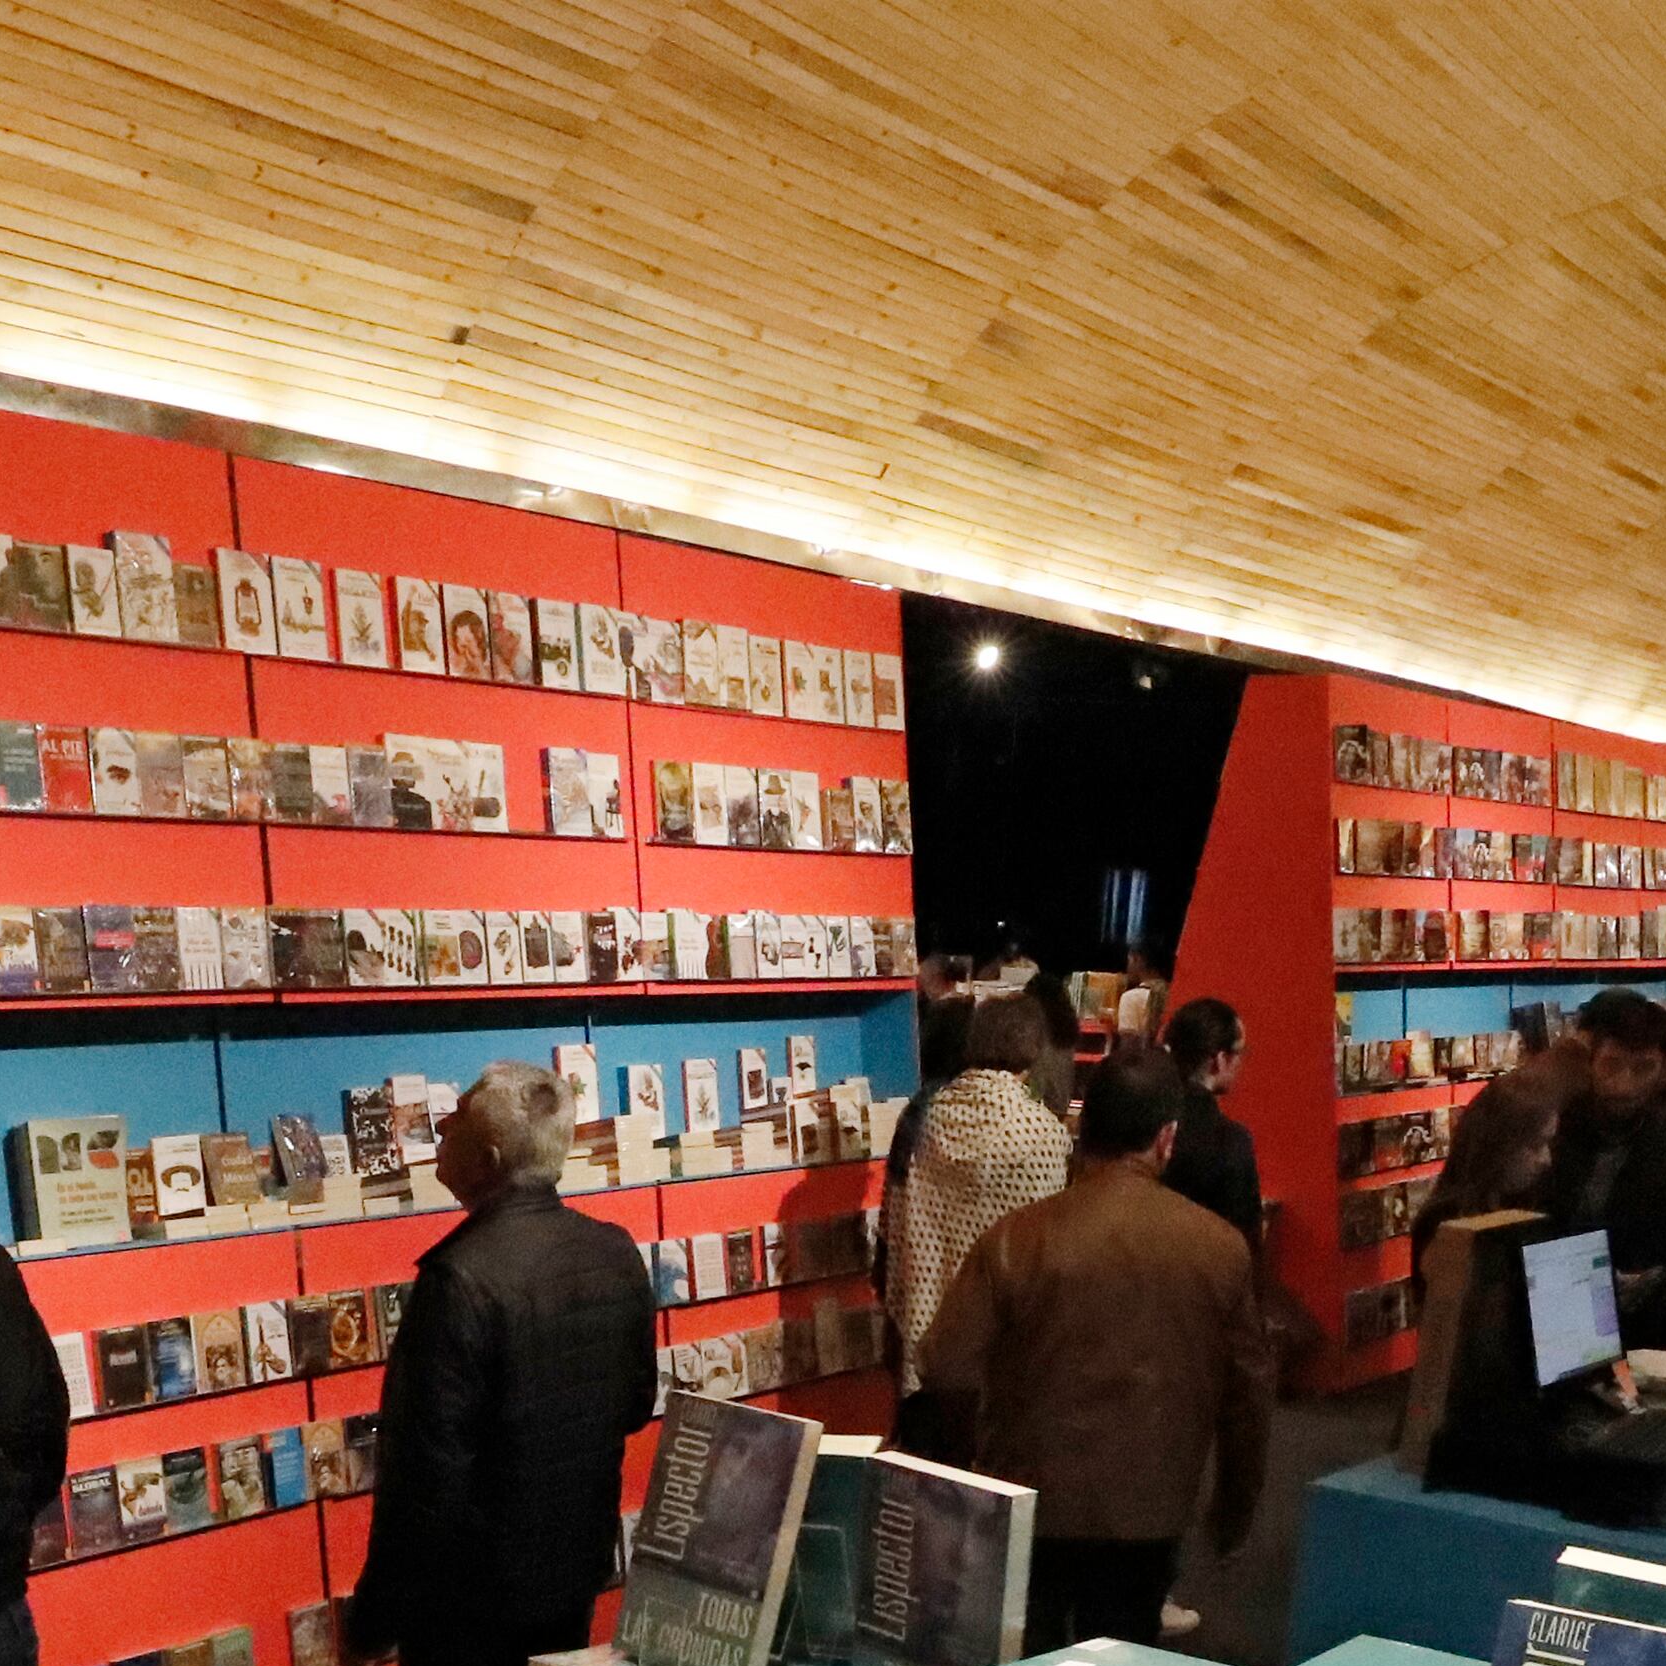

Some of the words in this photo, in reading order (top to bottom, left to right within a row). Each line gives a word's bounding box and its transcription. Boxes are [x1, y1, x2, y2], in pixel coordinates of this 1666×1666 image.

[636, 1420, 713, 1562] Lispector
[696, 1592, 754, 1640] TODAS
[856, 1498, 922, 1642] Lispector
[1527, 1609, 1596, 1653] CLARICE
